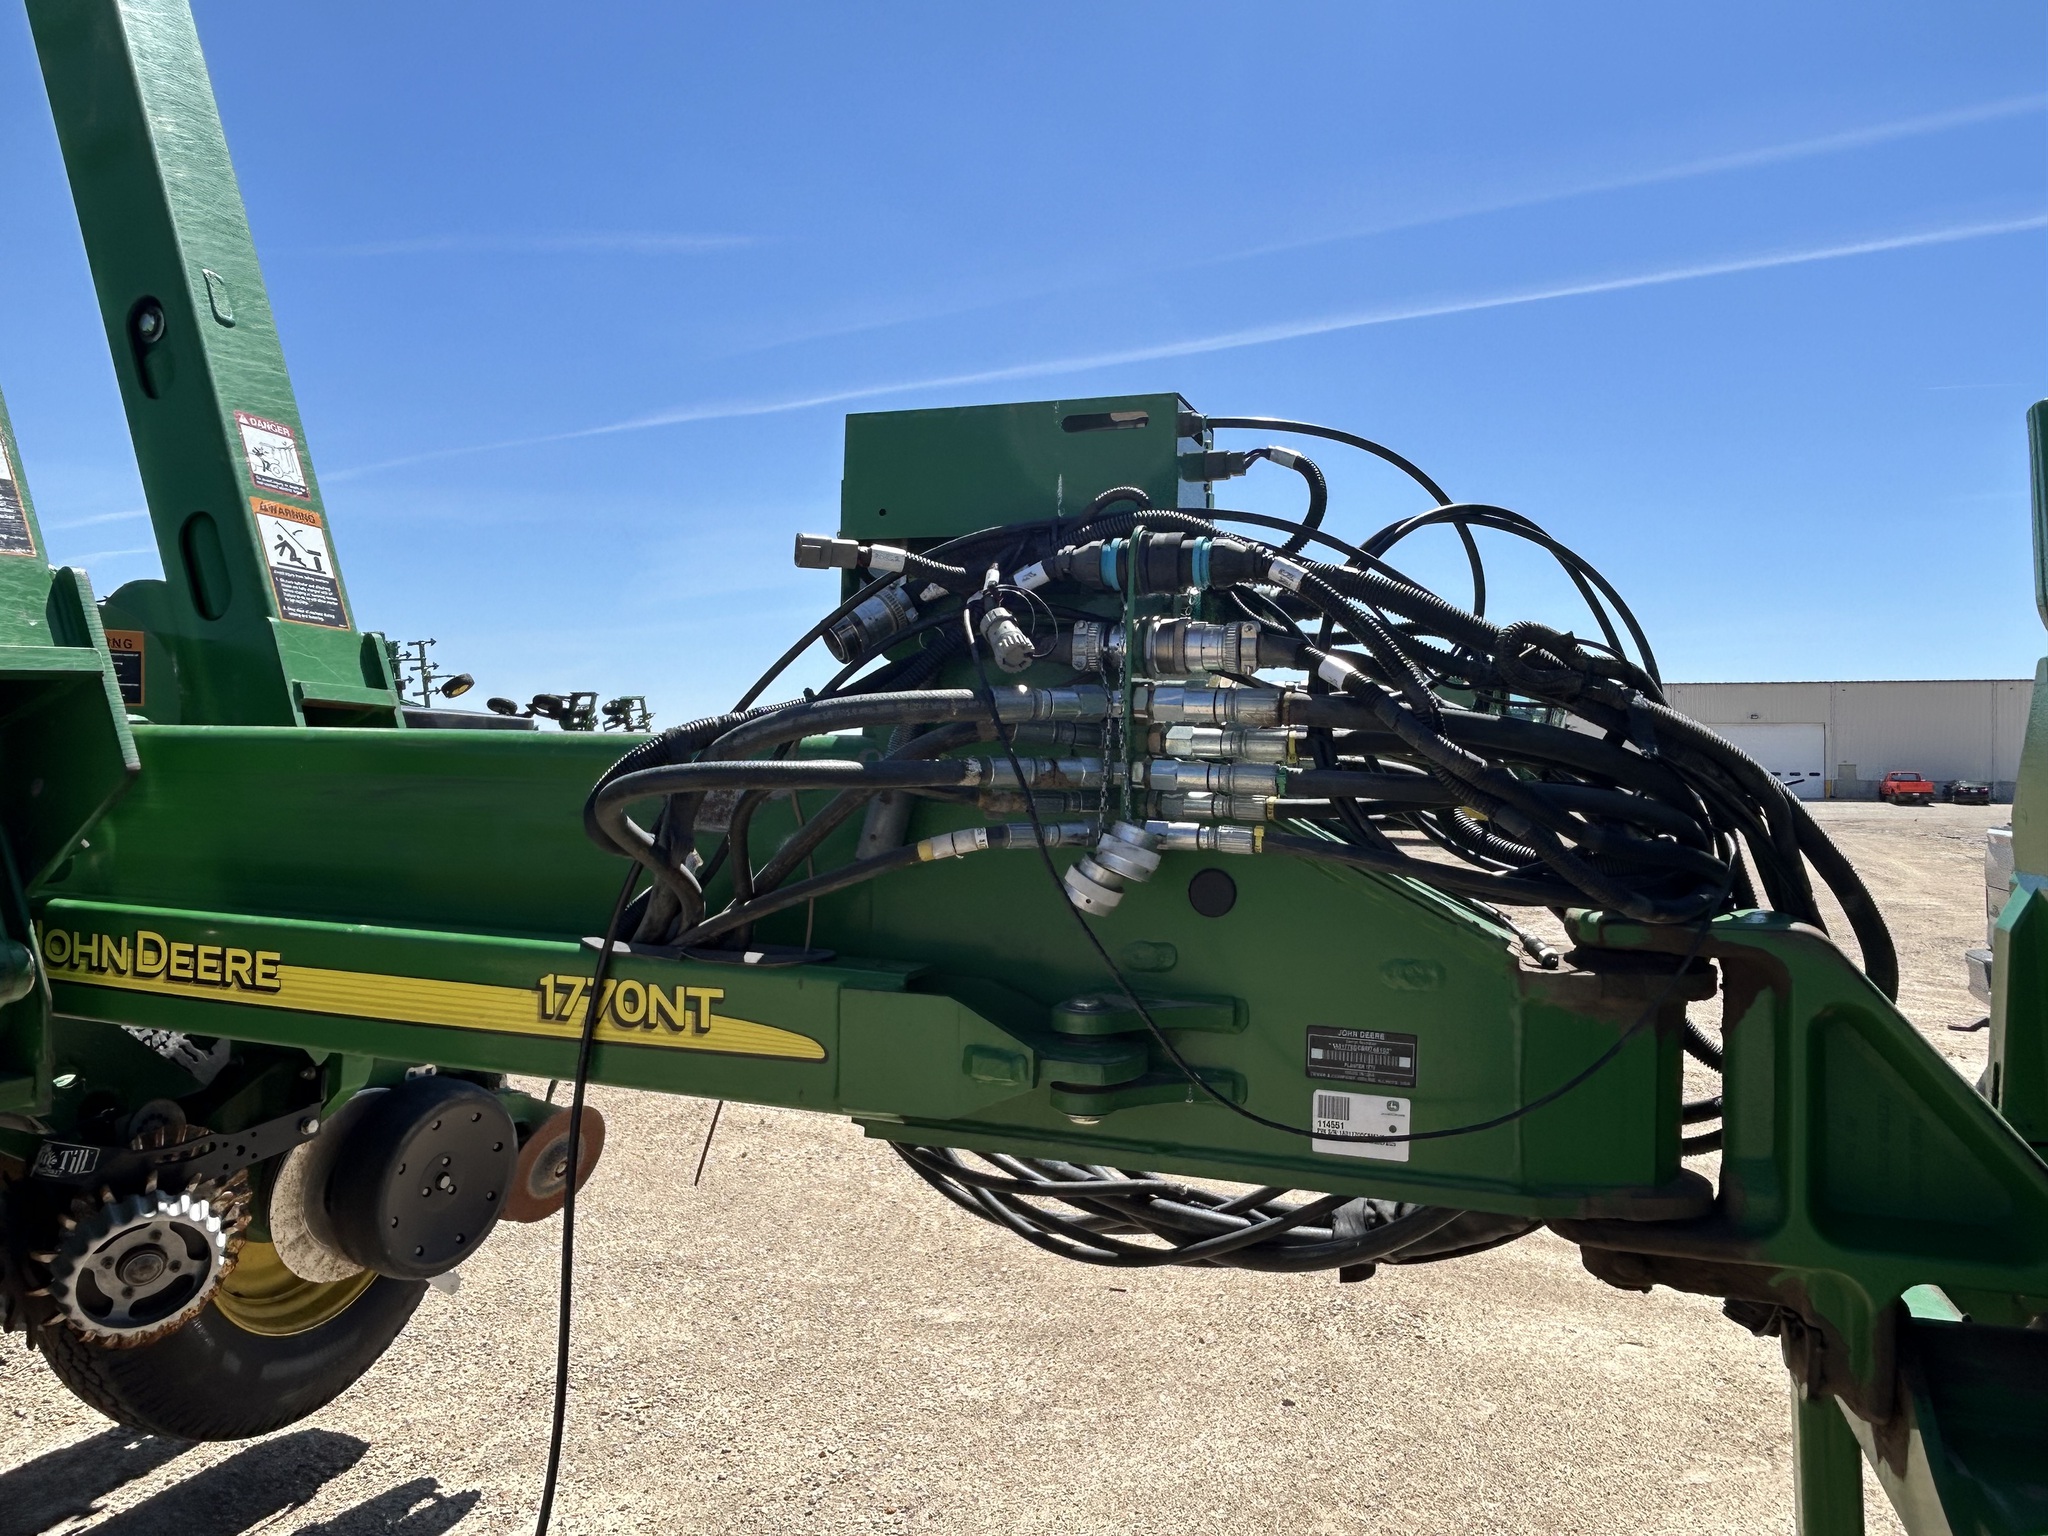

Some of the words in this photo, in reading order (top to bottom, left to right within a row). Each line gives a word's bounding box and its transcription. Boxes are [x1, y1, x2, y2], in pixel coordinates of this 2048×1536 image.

[249, 417, 291, 437] DANGER
[268, 504, 316, 524] WARNING
[136, 930, 281, 991] DEERE
[538, 973, 725, 1032] 1770NT
[1338, 1029, 1358, 1038] JOHN
[1359, 1031, 1385, 1040] DEERE
[1317, 1119, 1344, 1130] 114551
[59, 1149, 90, 1174] Till
